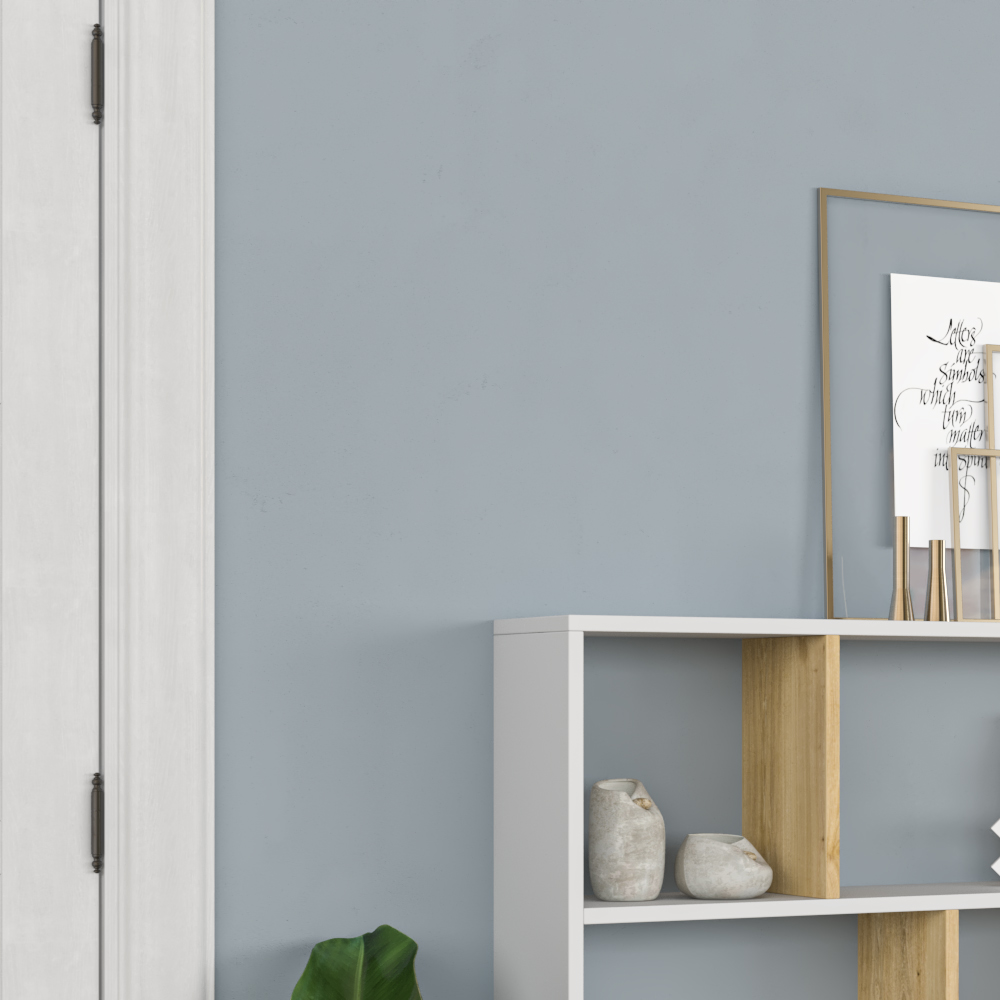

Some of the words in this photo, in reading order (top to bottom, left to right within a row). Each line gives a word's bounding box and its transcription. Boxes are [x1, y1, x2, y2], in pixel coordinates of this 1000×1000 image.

[926, 317, 983, 350] Letters
[956, 348, 978, 364] are
[942, 404, 971, 430] turn
[948, 420, 986, 448] matter
[934, 448, 949, 471] int
